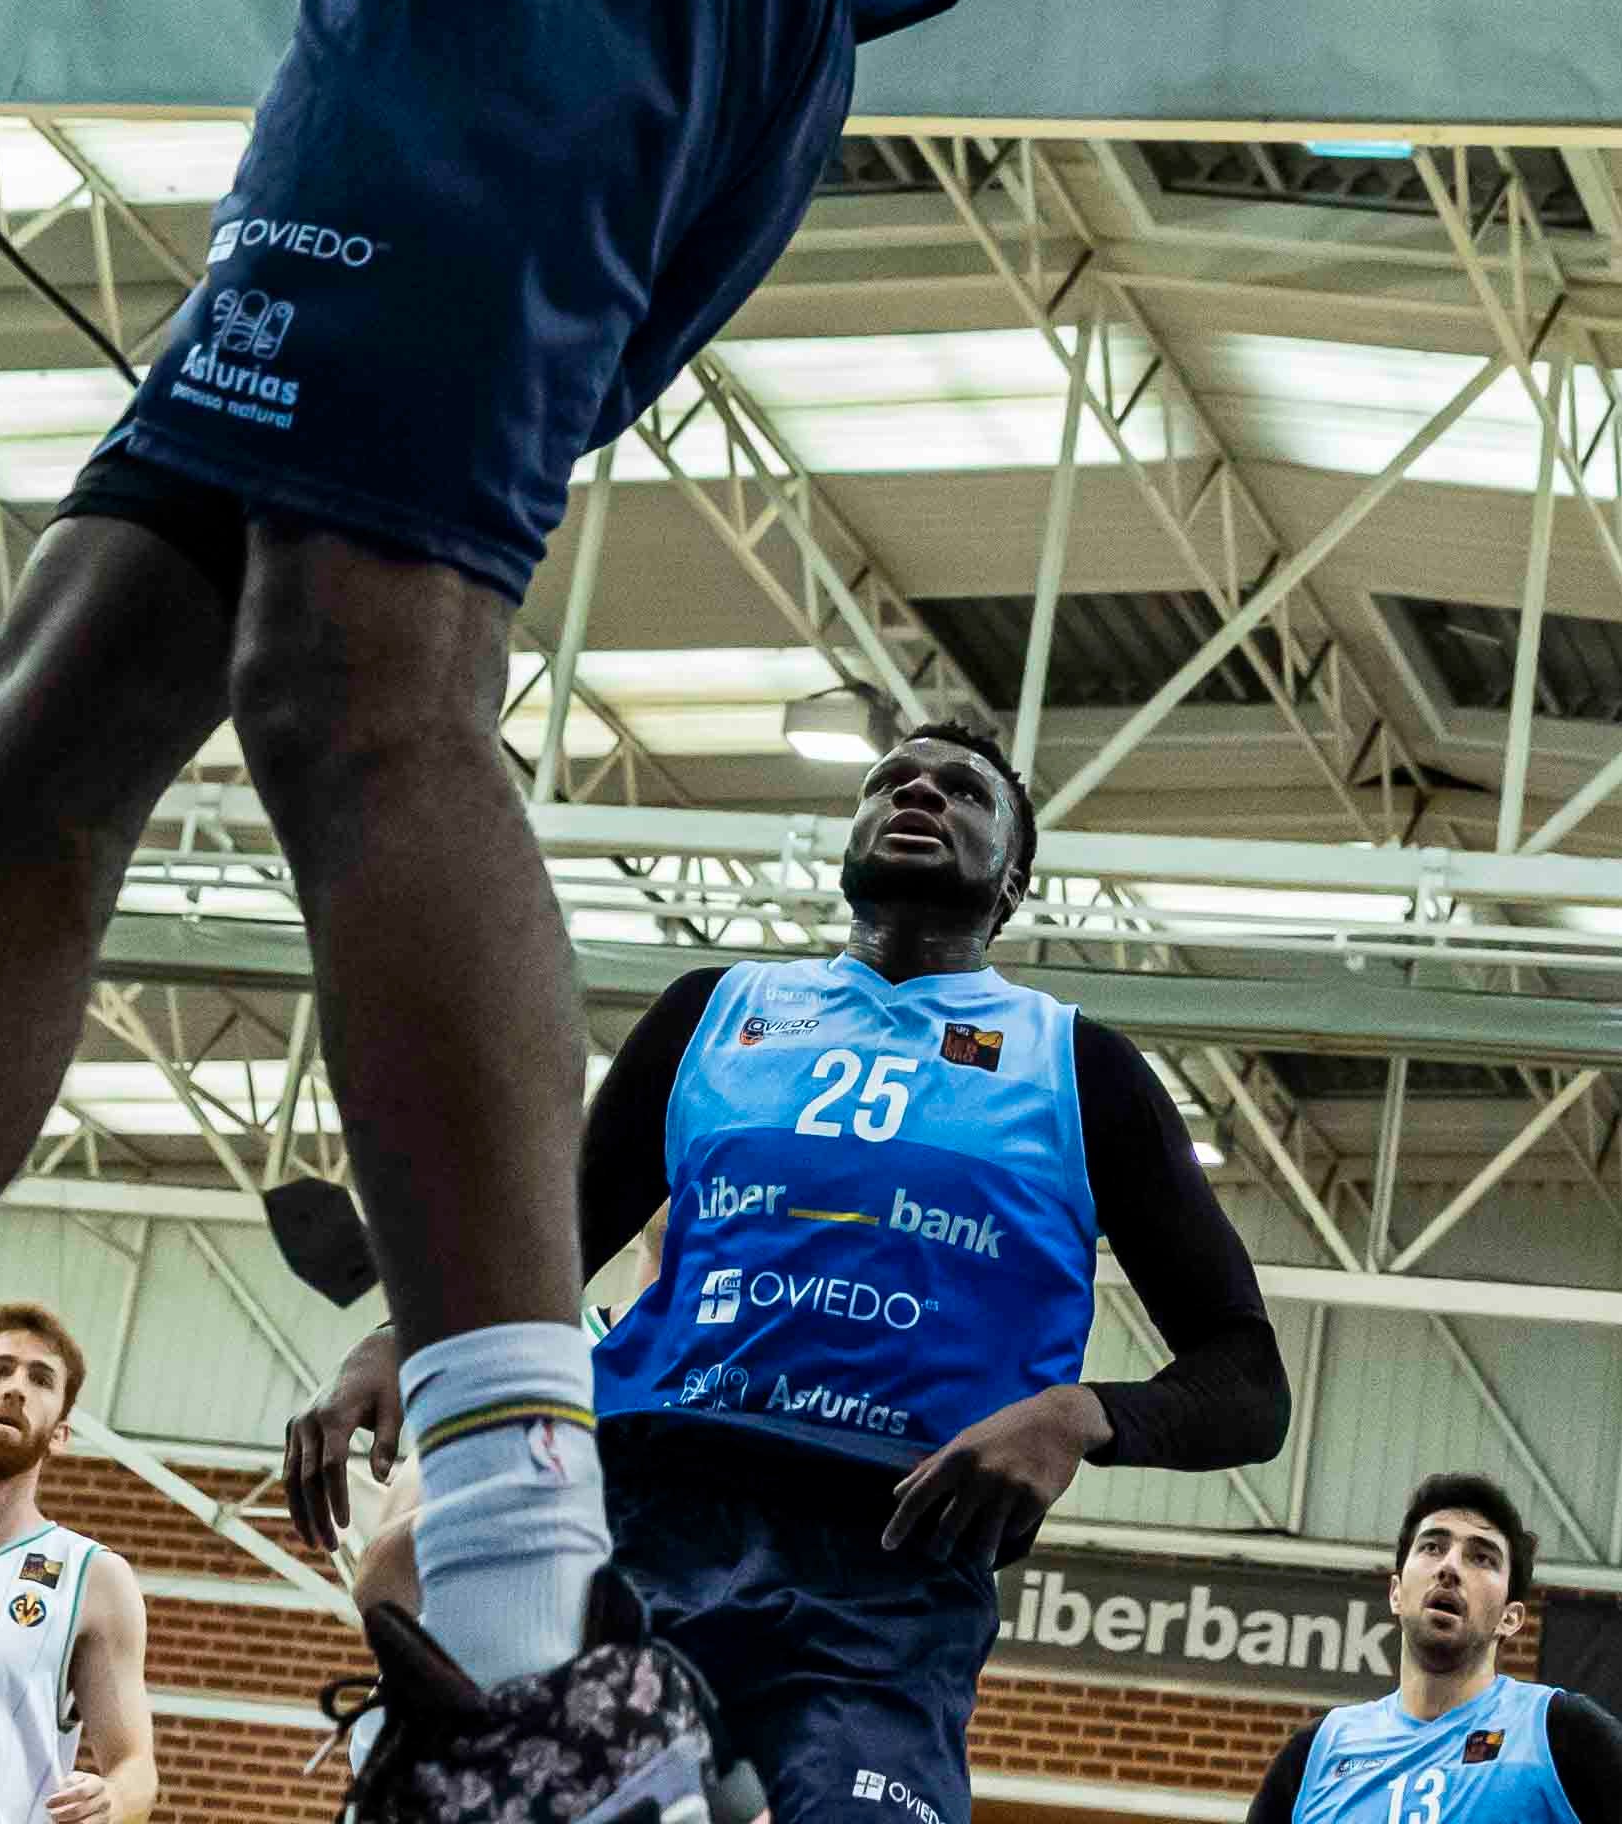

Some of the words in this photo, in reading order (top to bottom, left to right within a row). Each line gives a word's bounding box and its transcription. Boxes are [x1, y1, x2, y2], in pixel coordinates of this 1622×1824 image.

[242, 218, 373, 266] OVIEDO
[180, 342, 300, 406] Asturias
[794, 1048, 919, 1143] 25
[697, 1175, 787, 1219] Liber
[889, 1187, 1007, 1259] bank
[766, 1373, 911, 1436] Asturias
[888, 1781, 947, 1824] OVIED
[1387, 1767, 1445, 1824] 13
